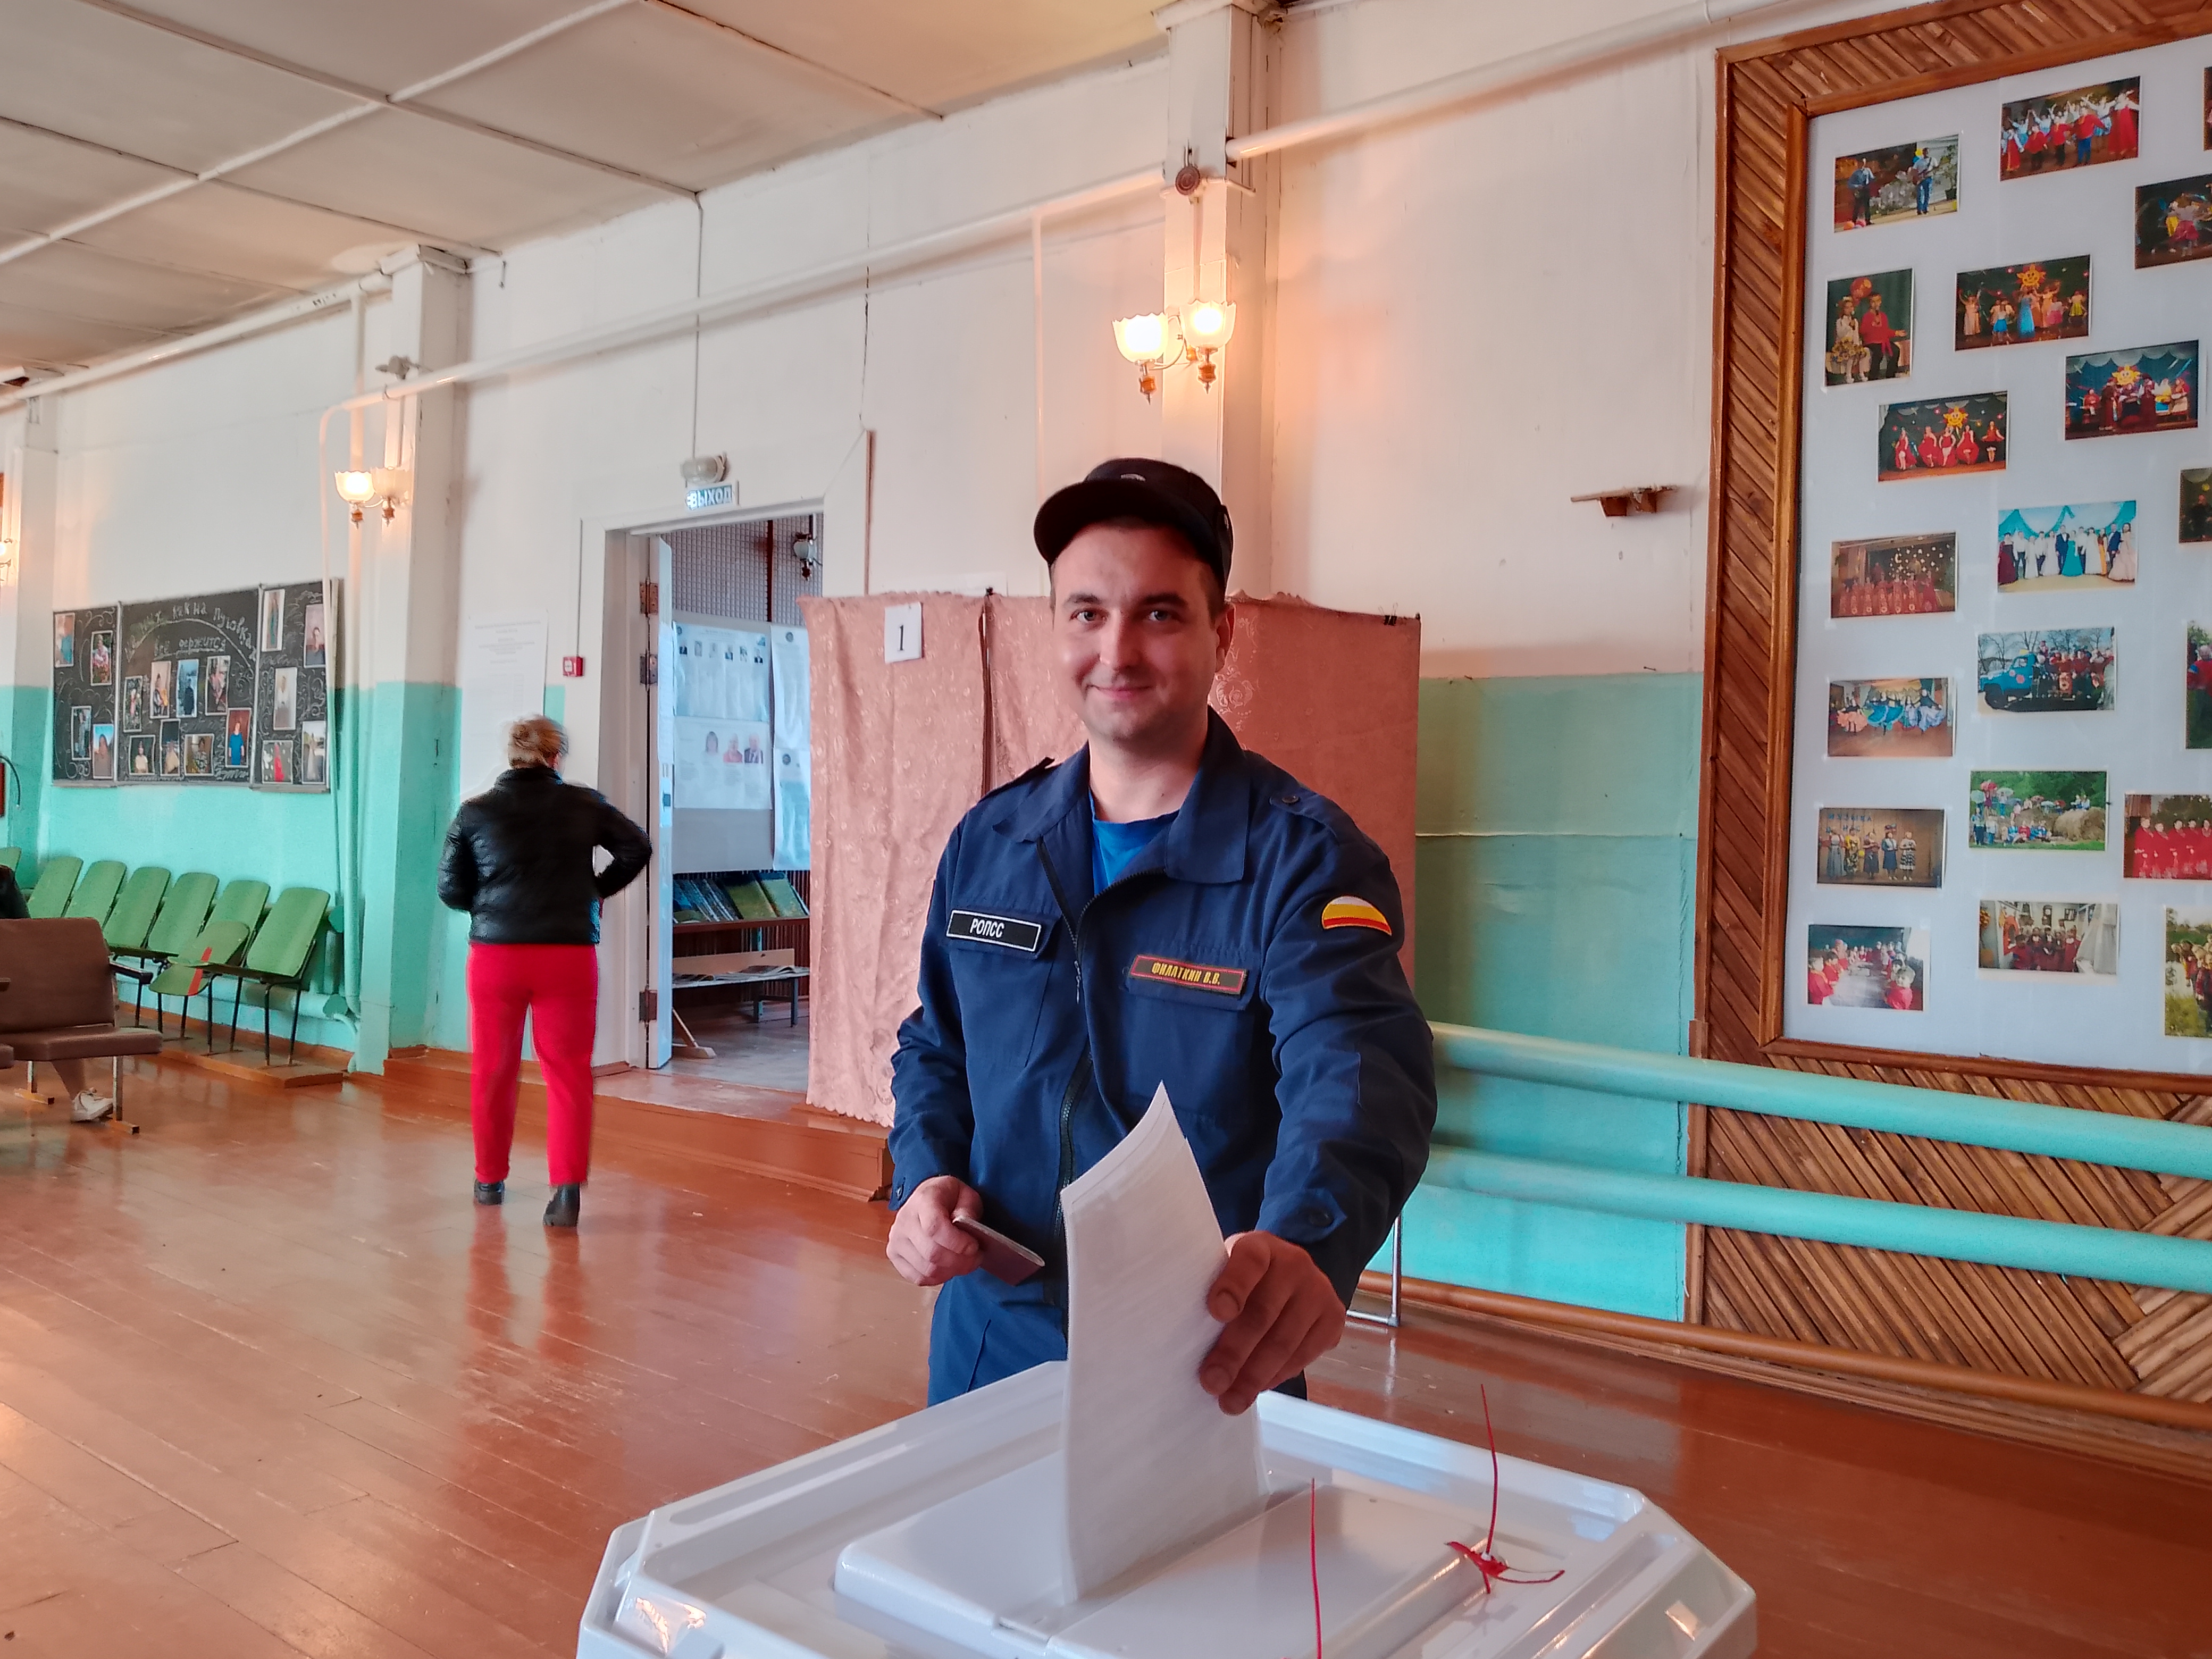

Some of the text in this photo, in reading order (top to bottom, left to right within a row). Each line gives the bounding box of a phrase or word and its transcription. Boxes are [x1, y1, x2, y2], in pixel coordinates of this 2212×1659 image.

[690, 486, 732, 509] ВЫХОД
[898, 624, 904, 651] 1
[969, 918, 1005, 938] РОПСС
[1151, 961, 1221, 985] ФИЛАТКИН В.В.
